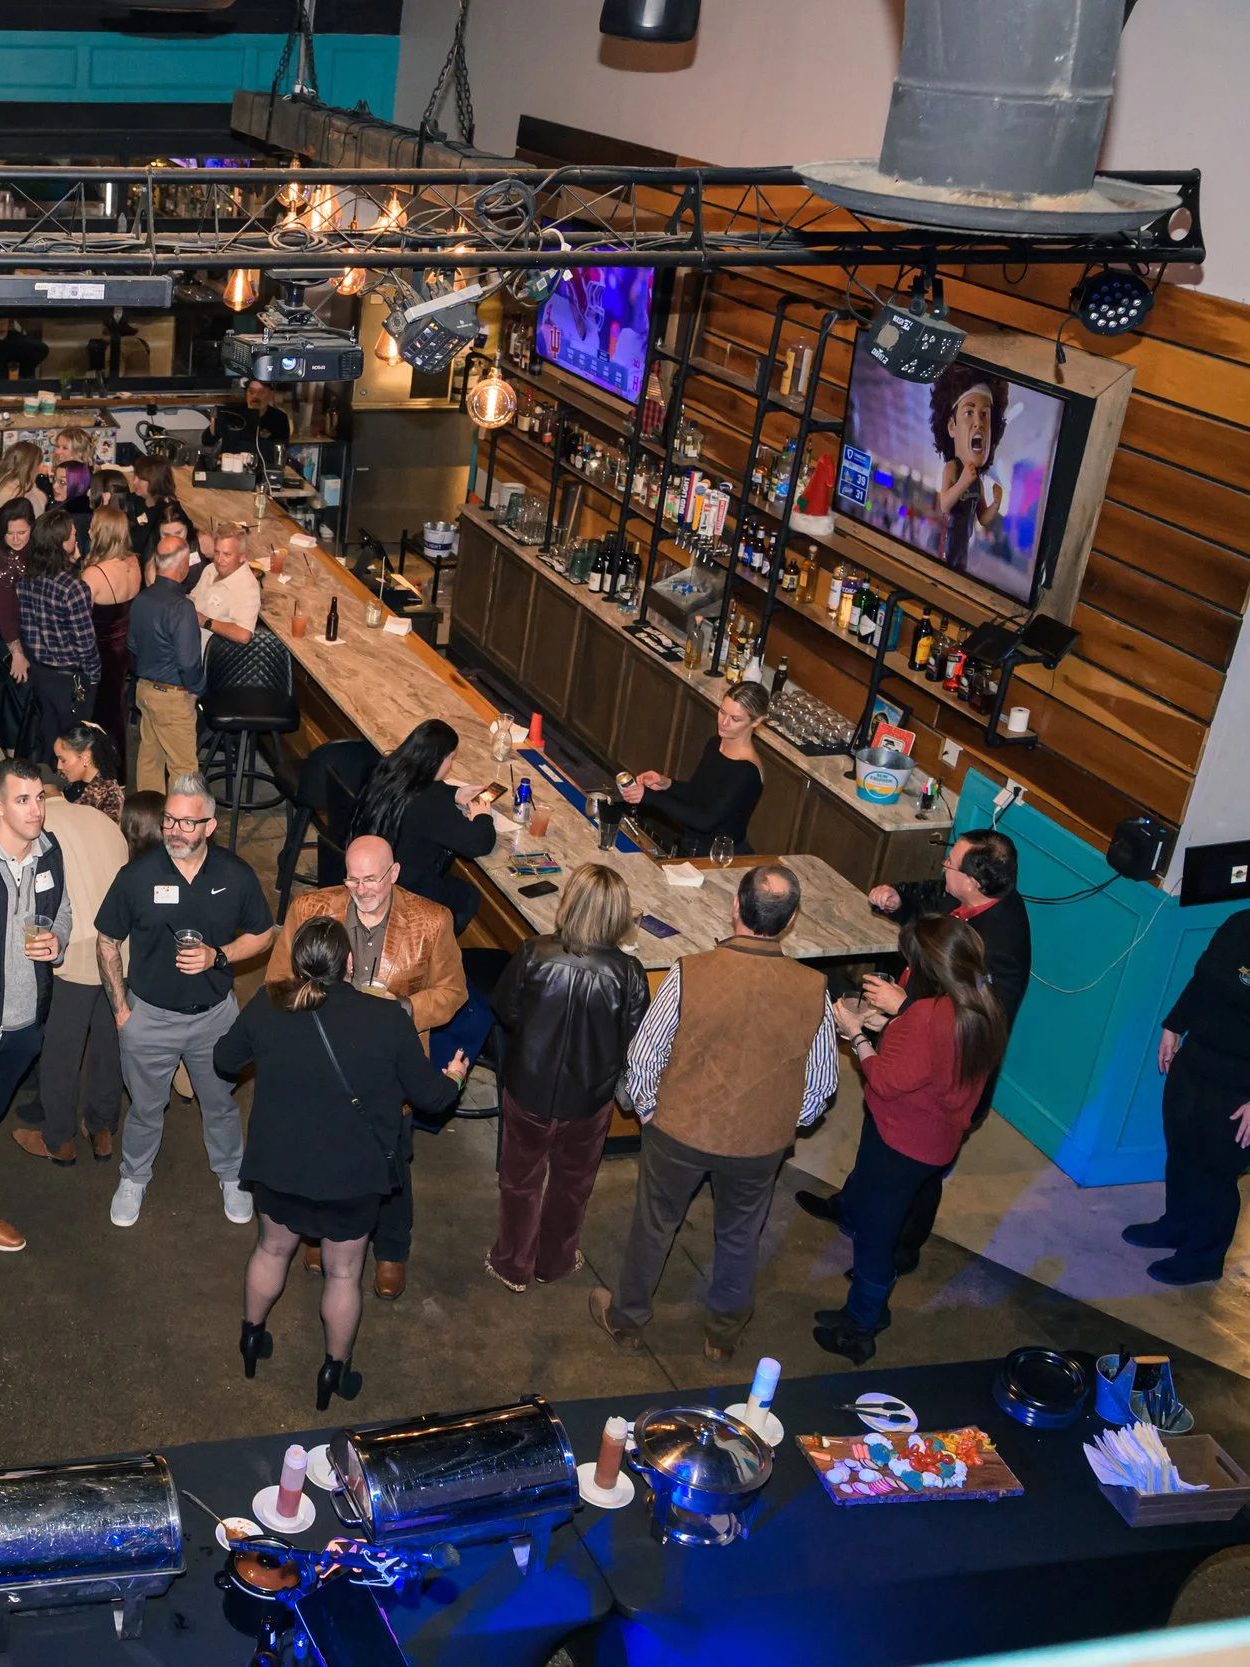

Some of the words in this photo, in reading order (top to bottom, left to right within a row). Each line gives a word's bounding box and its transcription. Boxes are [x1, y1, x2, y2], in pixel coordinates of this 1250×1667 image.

[856, 473, 866, 486] 39
[683, 477, 691, 499] LIGHT
[855, 489, 864, 501] 31
